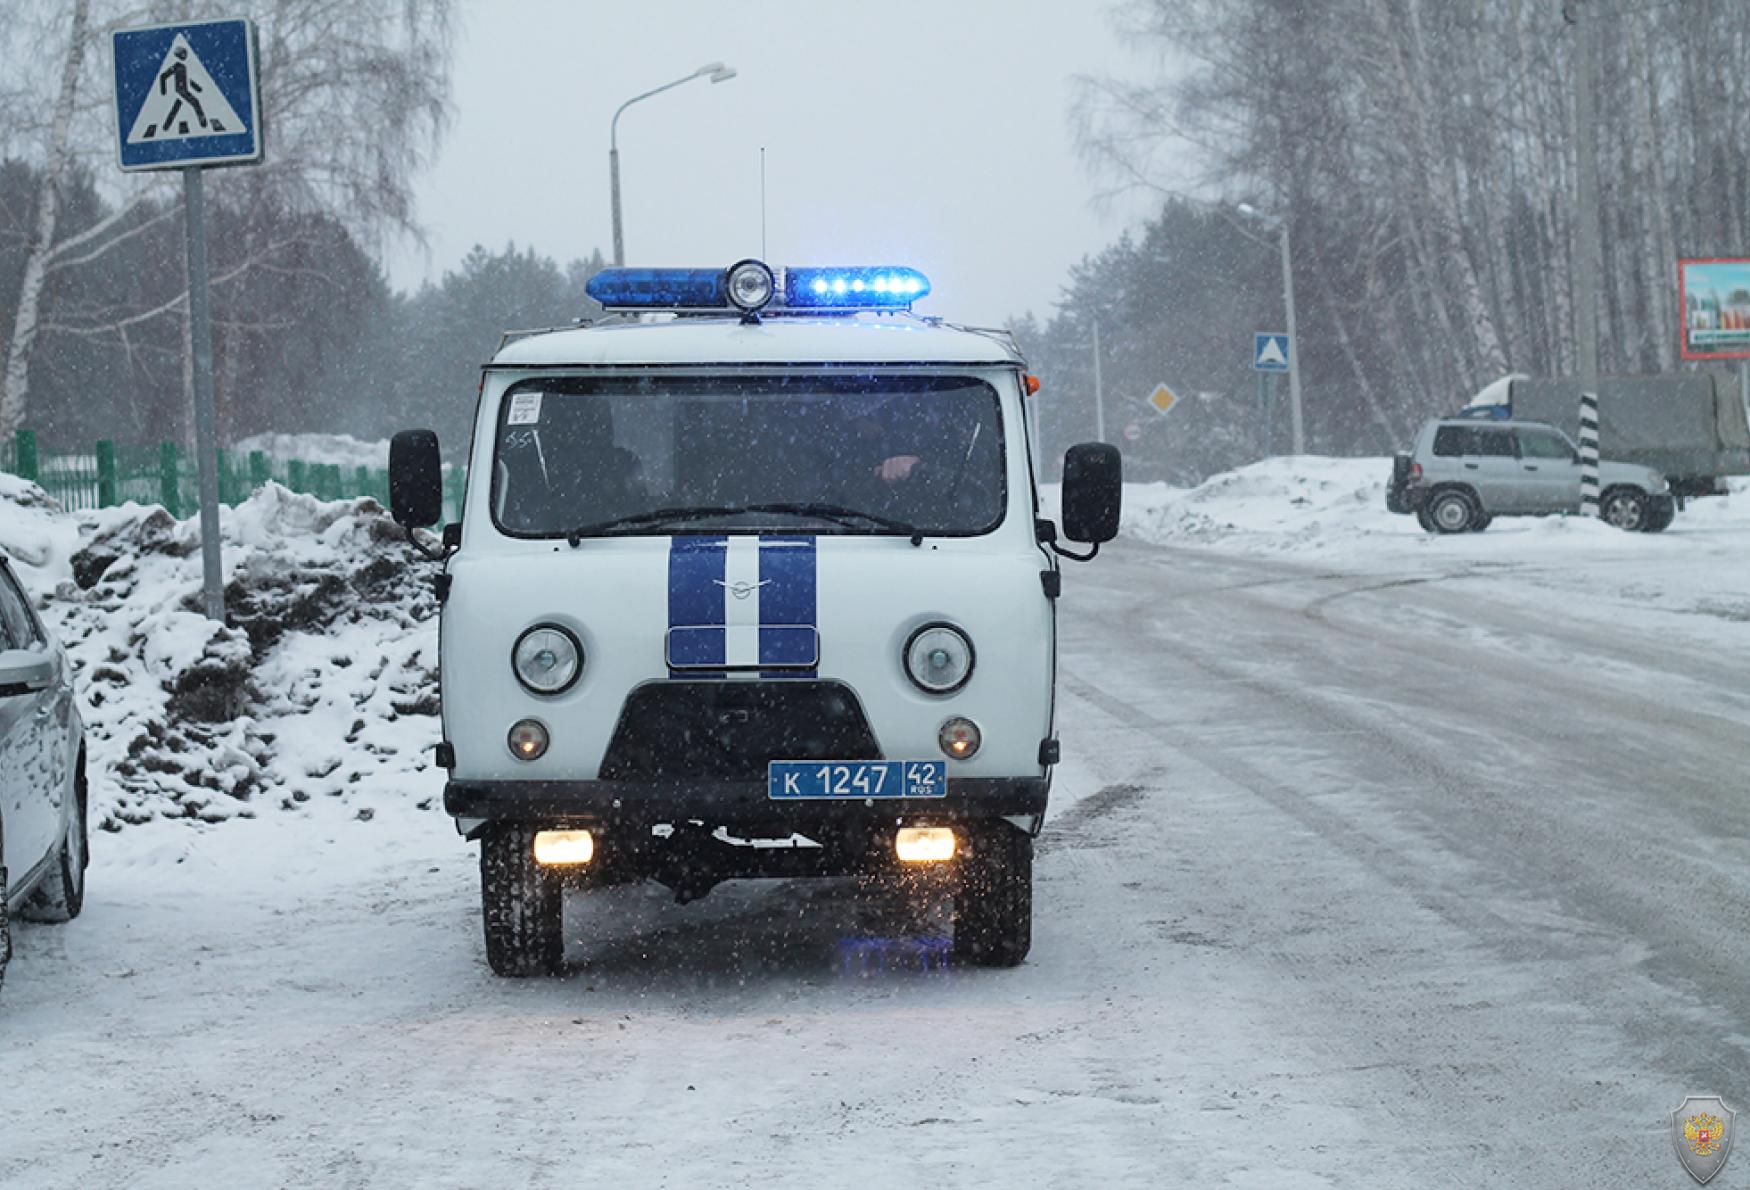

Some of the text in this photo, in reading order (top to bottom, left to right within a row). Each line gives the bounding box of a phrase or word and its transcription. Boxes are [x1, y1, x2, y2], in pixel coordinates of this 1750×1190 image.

[816, 766, 889, 794] 1247
[907, 763, 935, 784] 42
[910, 785, 932, 794] RUS
